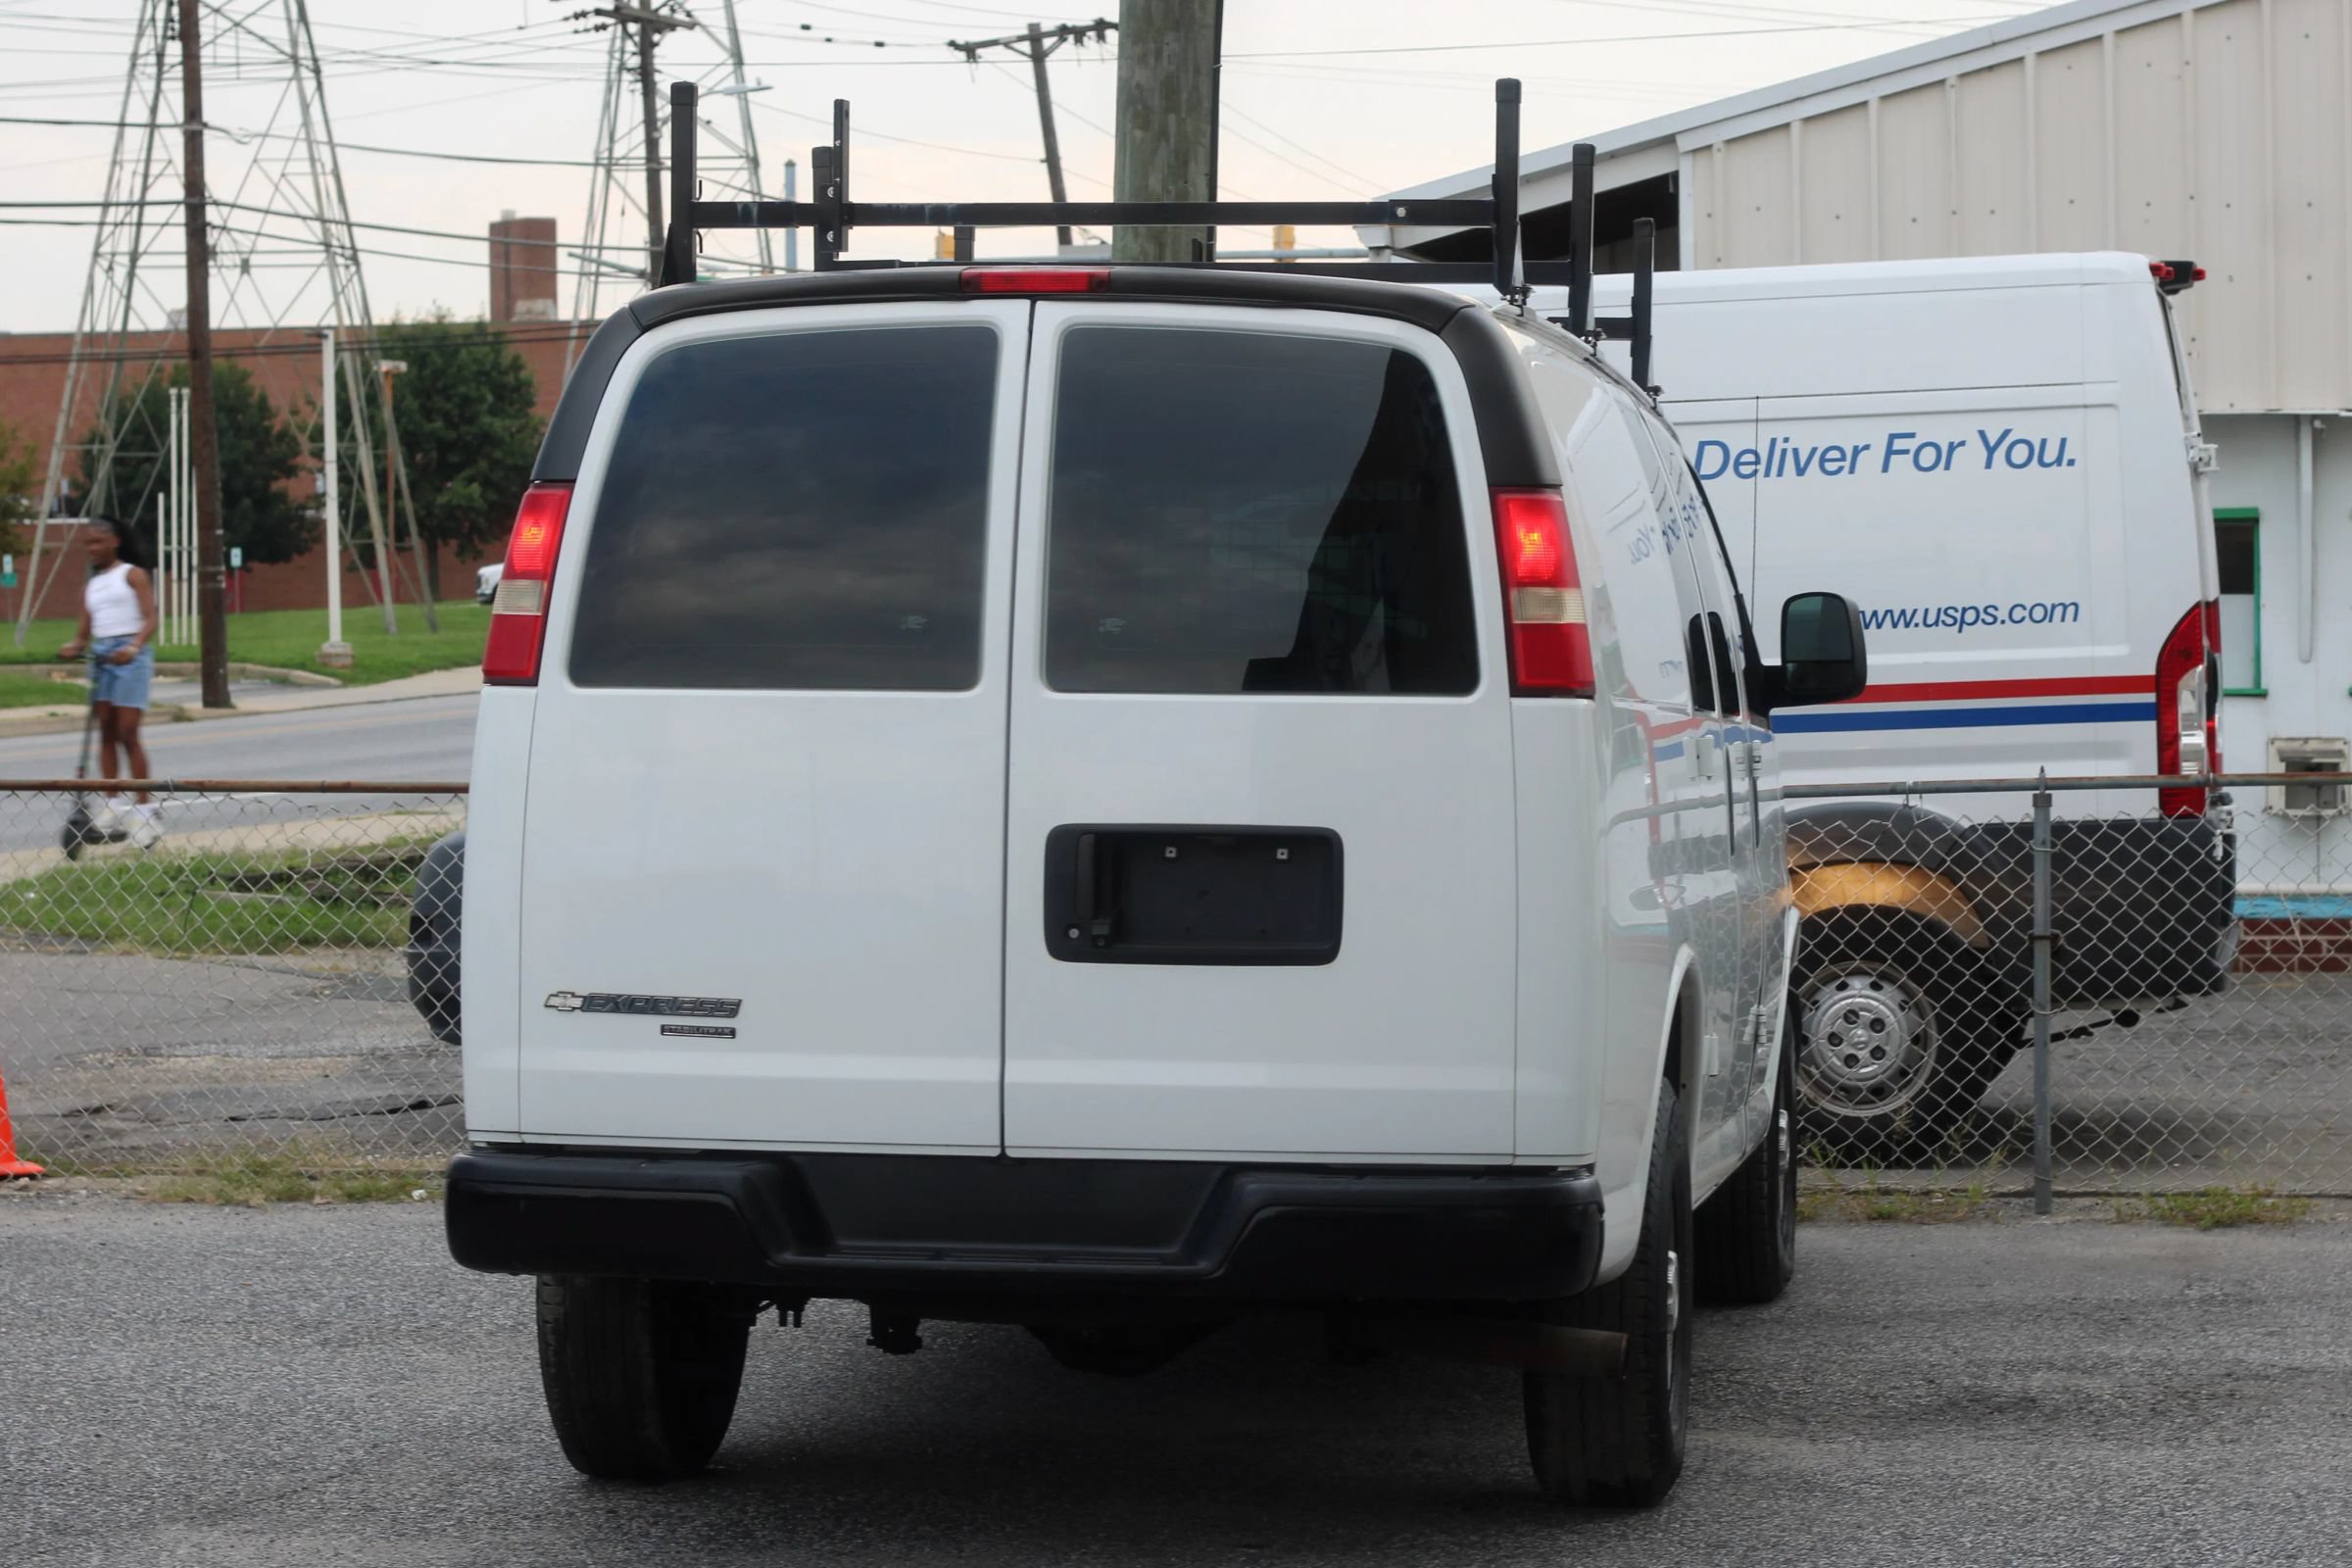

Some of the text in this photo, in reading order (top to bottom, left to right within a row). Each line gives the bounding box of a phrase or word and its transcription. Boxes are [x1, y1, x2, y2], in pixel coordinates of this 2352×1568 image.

[1694, 428, 2078, 480] Deliver For You.
[1859, 601, 2080, 633] ww.usps.com
[583, 993, 742, 1018] EXPRESS
